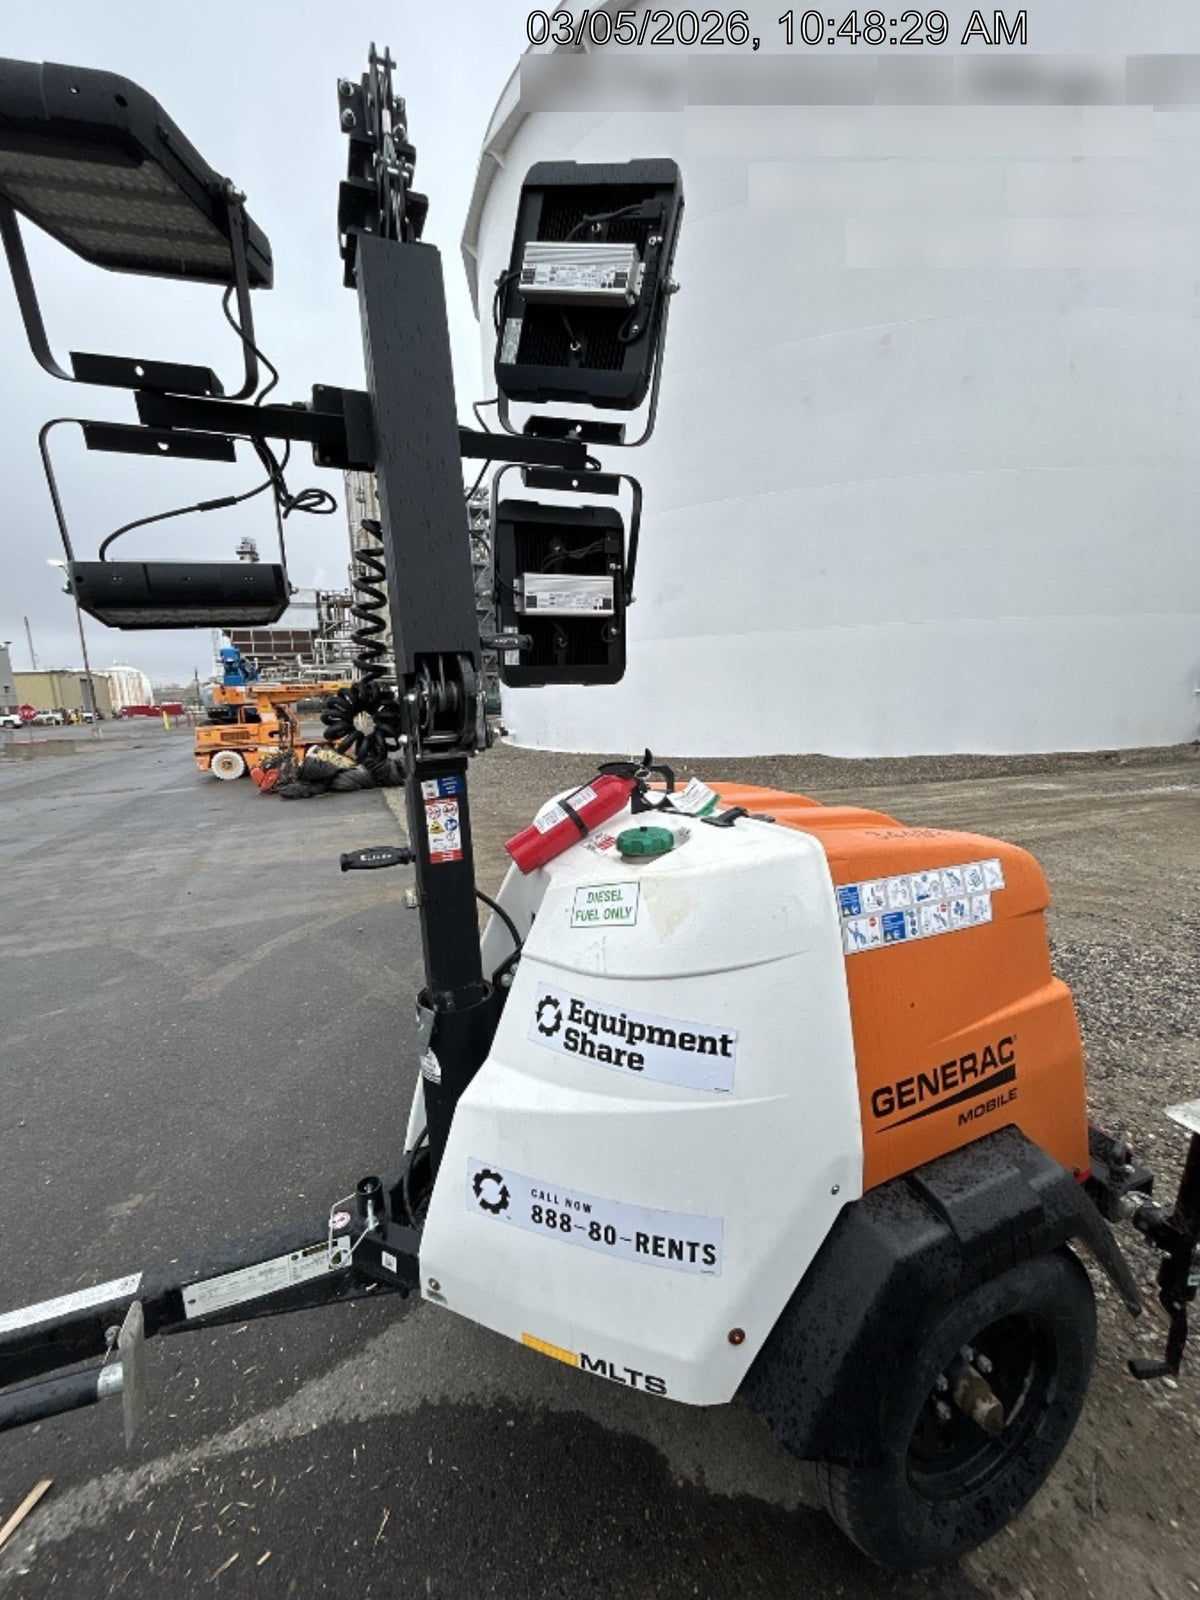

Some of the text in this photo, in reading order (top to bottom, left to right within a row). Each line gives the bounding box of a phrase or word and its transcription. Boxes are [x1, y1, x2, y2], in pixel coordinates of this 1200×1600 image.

[575, 906, 634, 922] FUEL ONLY
[586, 888, 624, 904] DIESEL
[563, 1027, 645, 1072] Share
[567, 998, 734, 1058] Equipment
[871, 1035, 1015, 1118] GENERAC
[958, 1087, 1018, 1126] MOBILE
[531, 1188, 593, 1214] CALL NOW
[531, 1204, 717, 1266] 888-80-RENTS
[579, 1352, 668, 1396] MLTS
